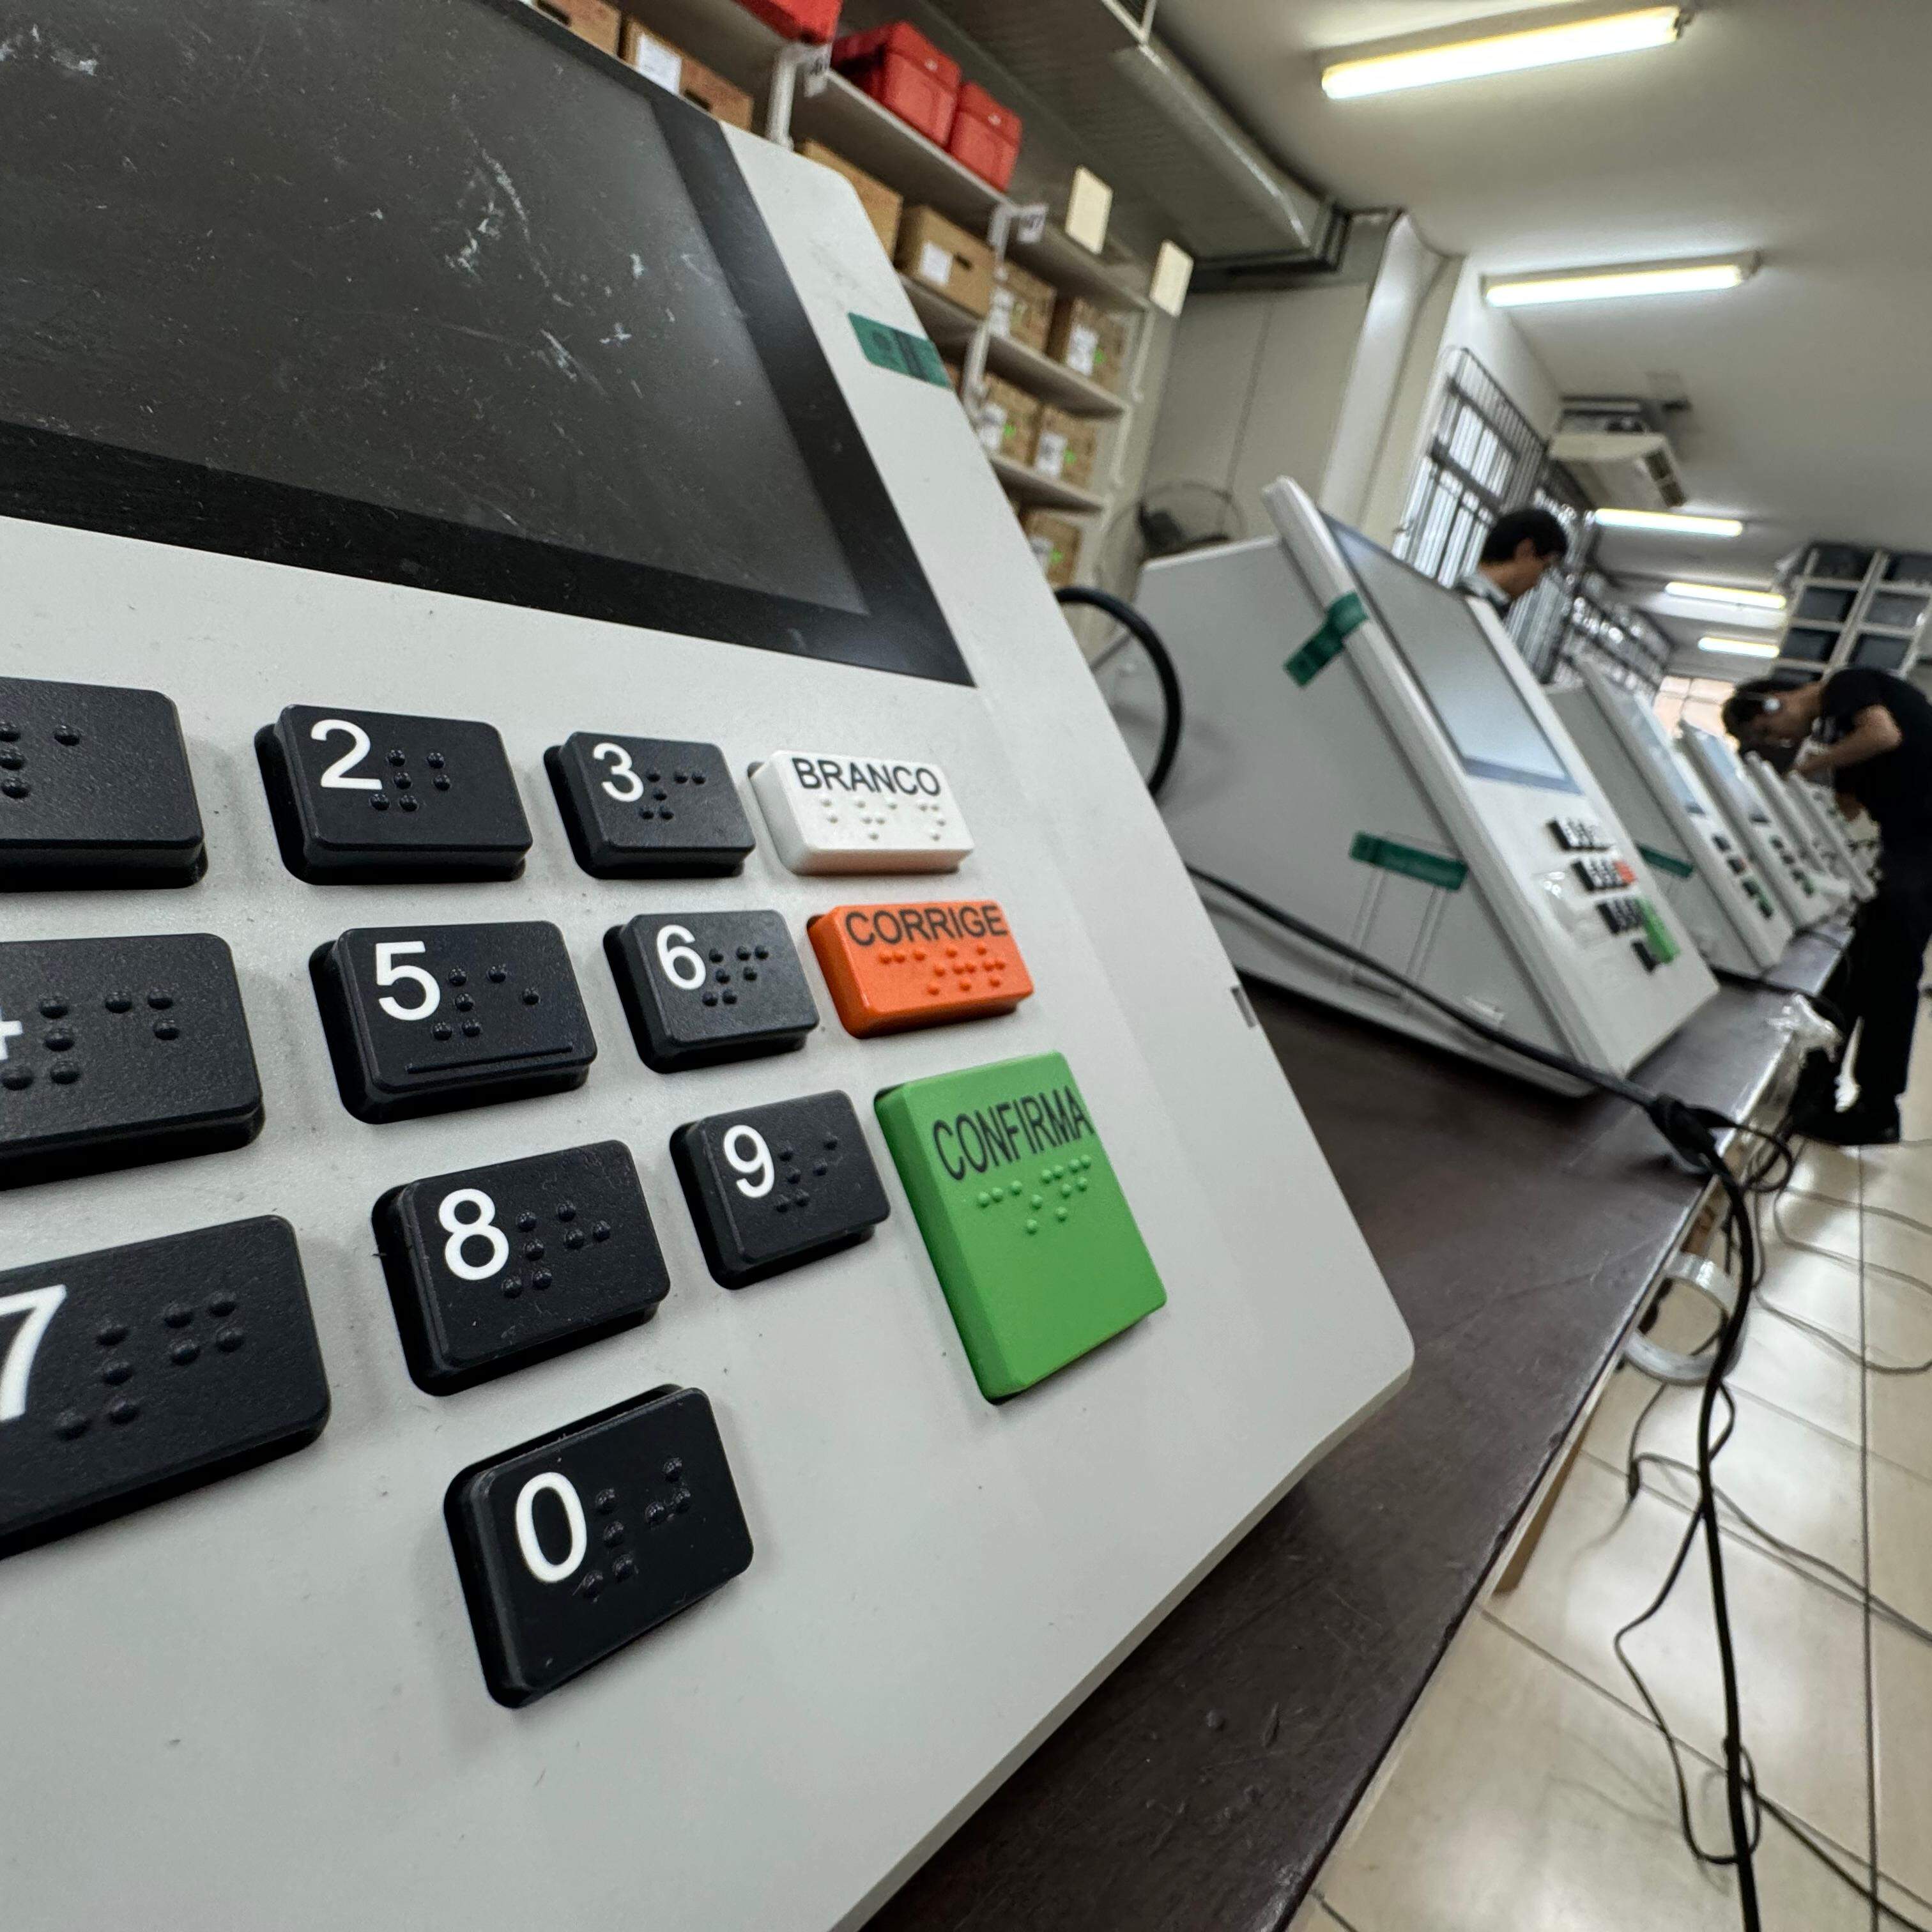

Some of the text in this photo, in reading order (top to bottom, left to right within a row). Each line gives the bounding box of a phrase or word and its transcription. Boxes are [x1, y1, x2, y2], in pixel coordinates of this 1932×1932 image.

[310, 719, 383, 790] 2
[593, 742, 644, 802] 3
[792, 757, 942, 795] BRANCO
[656, 924, 707, 990] 6
[845, 905, 1008, 947] CORRIGE
[375, 940, 440, 1021] 5
[723, 1124, 775, 1198] 9
[933, 1085, 1093, 1181] CONFIRMA
[438, 1188, 509, 1280] 8
[0, 1284, 66, 1422] 7
[516, 1472, 587, 1582] 0
